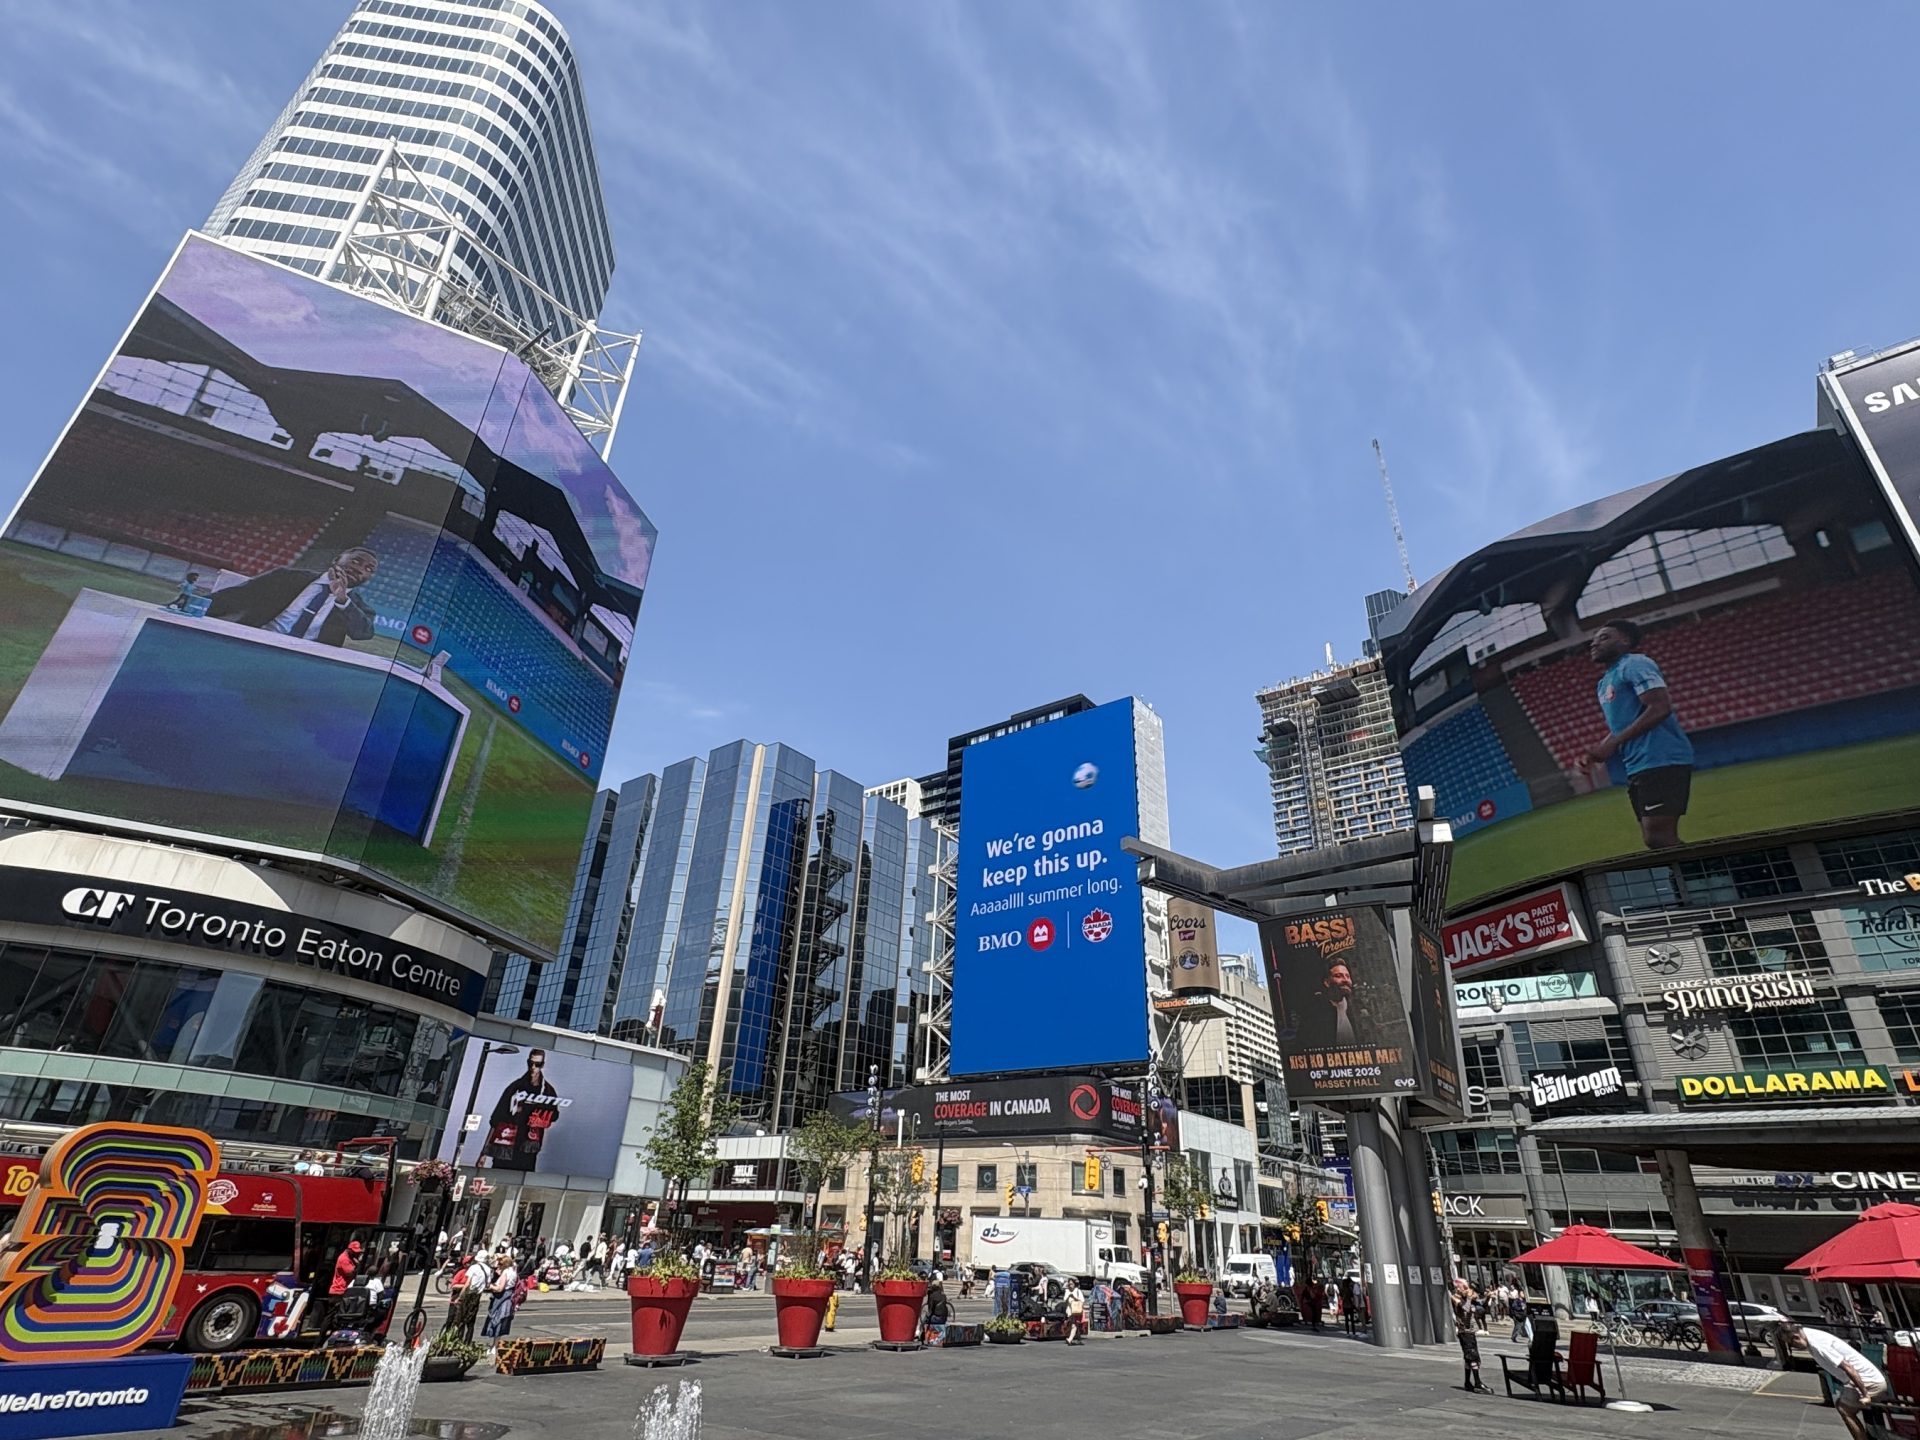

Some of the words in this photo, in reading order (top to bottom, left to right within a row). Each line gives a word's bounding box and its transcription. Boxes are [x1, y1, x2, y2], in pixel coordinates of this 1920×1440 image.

[1864, 378, 1920, 413] SA
[986, 833, 1036, 858] We're
[1041, 819, 1104, 851] gonna
[982, 867, 1028, 888] keep
[1033, 853, 1070, 877] this
[1076, 850, 1108, 871] up.
[1028, 883, 1084, 906] summer
[1087, 877, 1123, 895] long.
[1858, 878, 1907, 896] The
[1531, 901, 1559, 918] PARTY
[1082, 920, 1112, 931] CANADA
[1169, 914, 1207, 932] Coors
[1533, 914, 1556, 928] THIS
[1860, 912, 1908, 934] Hard
[1448, 911, 1534, 964] JACK'S
[1536, 924, 1556, 938] WAY
[61, 887, 136, 919] CF
[145, 896, 287, 948] Toronto
[296, 927, 383, 972] Eaton
[391, 953, 461, 997] Centre
[978, 930, 1022, 952] BMO
[1317, 935, 1356, 959] Toronto
[1661, 980, 1702, 991] LOUNGE
[1709, 972, 1782, 986] RESTAURANT
[1289, 1055, 1308, 1070] KISI
[1309, 1052, 1325, 1068] KO
[1326, 1050, 1374, 1068] BATANA
[1148, 1049, 1161, 1111] Yonge
[1329, 1068, 1354, 1079] JUNE
[1355, 1066, 1381, 1078] 2026
[1534, 1073, 1555, 1087] The
[1314, 1079, 1352, 1089] MASSEY
[1353, 1078, 1381, 1087] HALL
[1531, 1067, 1623, 1106] ballroom
[1594, 1085, 1619, 1098] BOWL
[1681, 1069, 1887, 1097] DOLLARAMA
[525, 1093, 573, 1107] LOTTO
[935, 1091, 949, 1103] THE
[950, 1090, 971, 1101] MOST
[1111, 1086, 1120, 1097] THE
[1120, 1088, 1132, 1100] MOST
[934, 1102, 988, 1119] COVERAGE
[989, 1101, 1001, 1116] IN
[1004, 1098, 1051, 1116] CANADA
[1111, 1110, 1118, 1121] IN
[1118, 1112, 1136, 1126] CANADA
[1831, 1171, 1920, 1189] CINE
